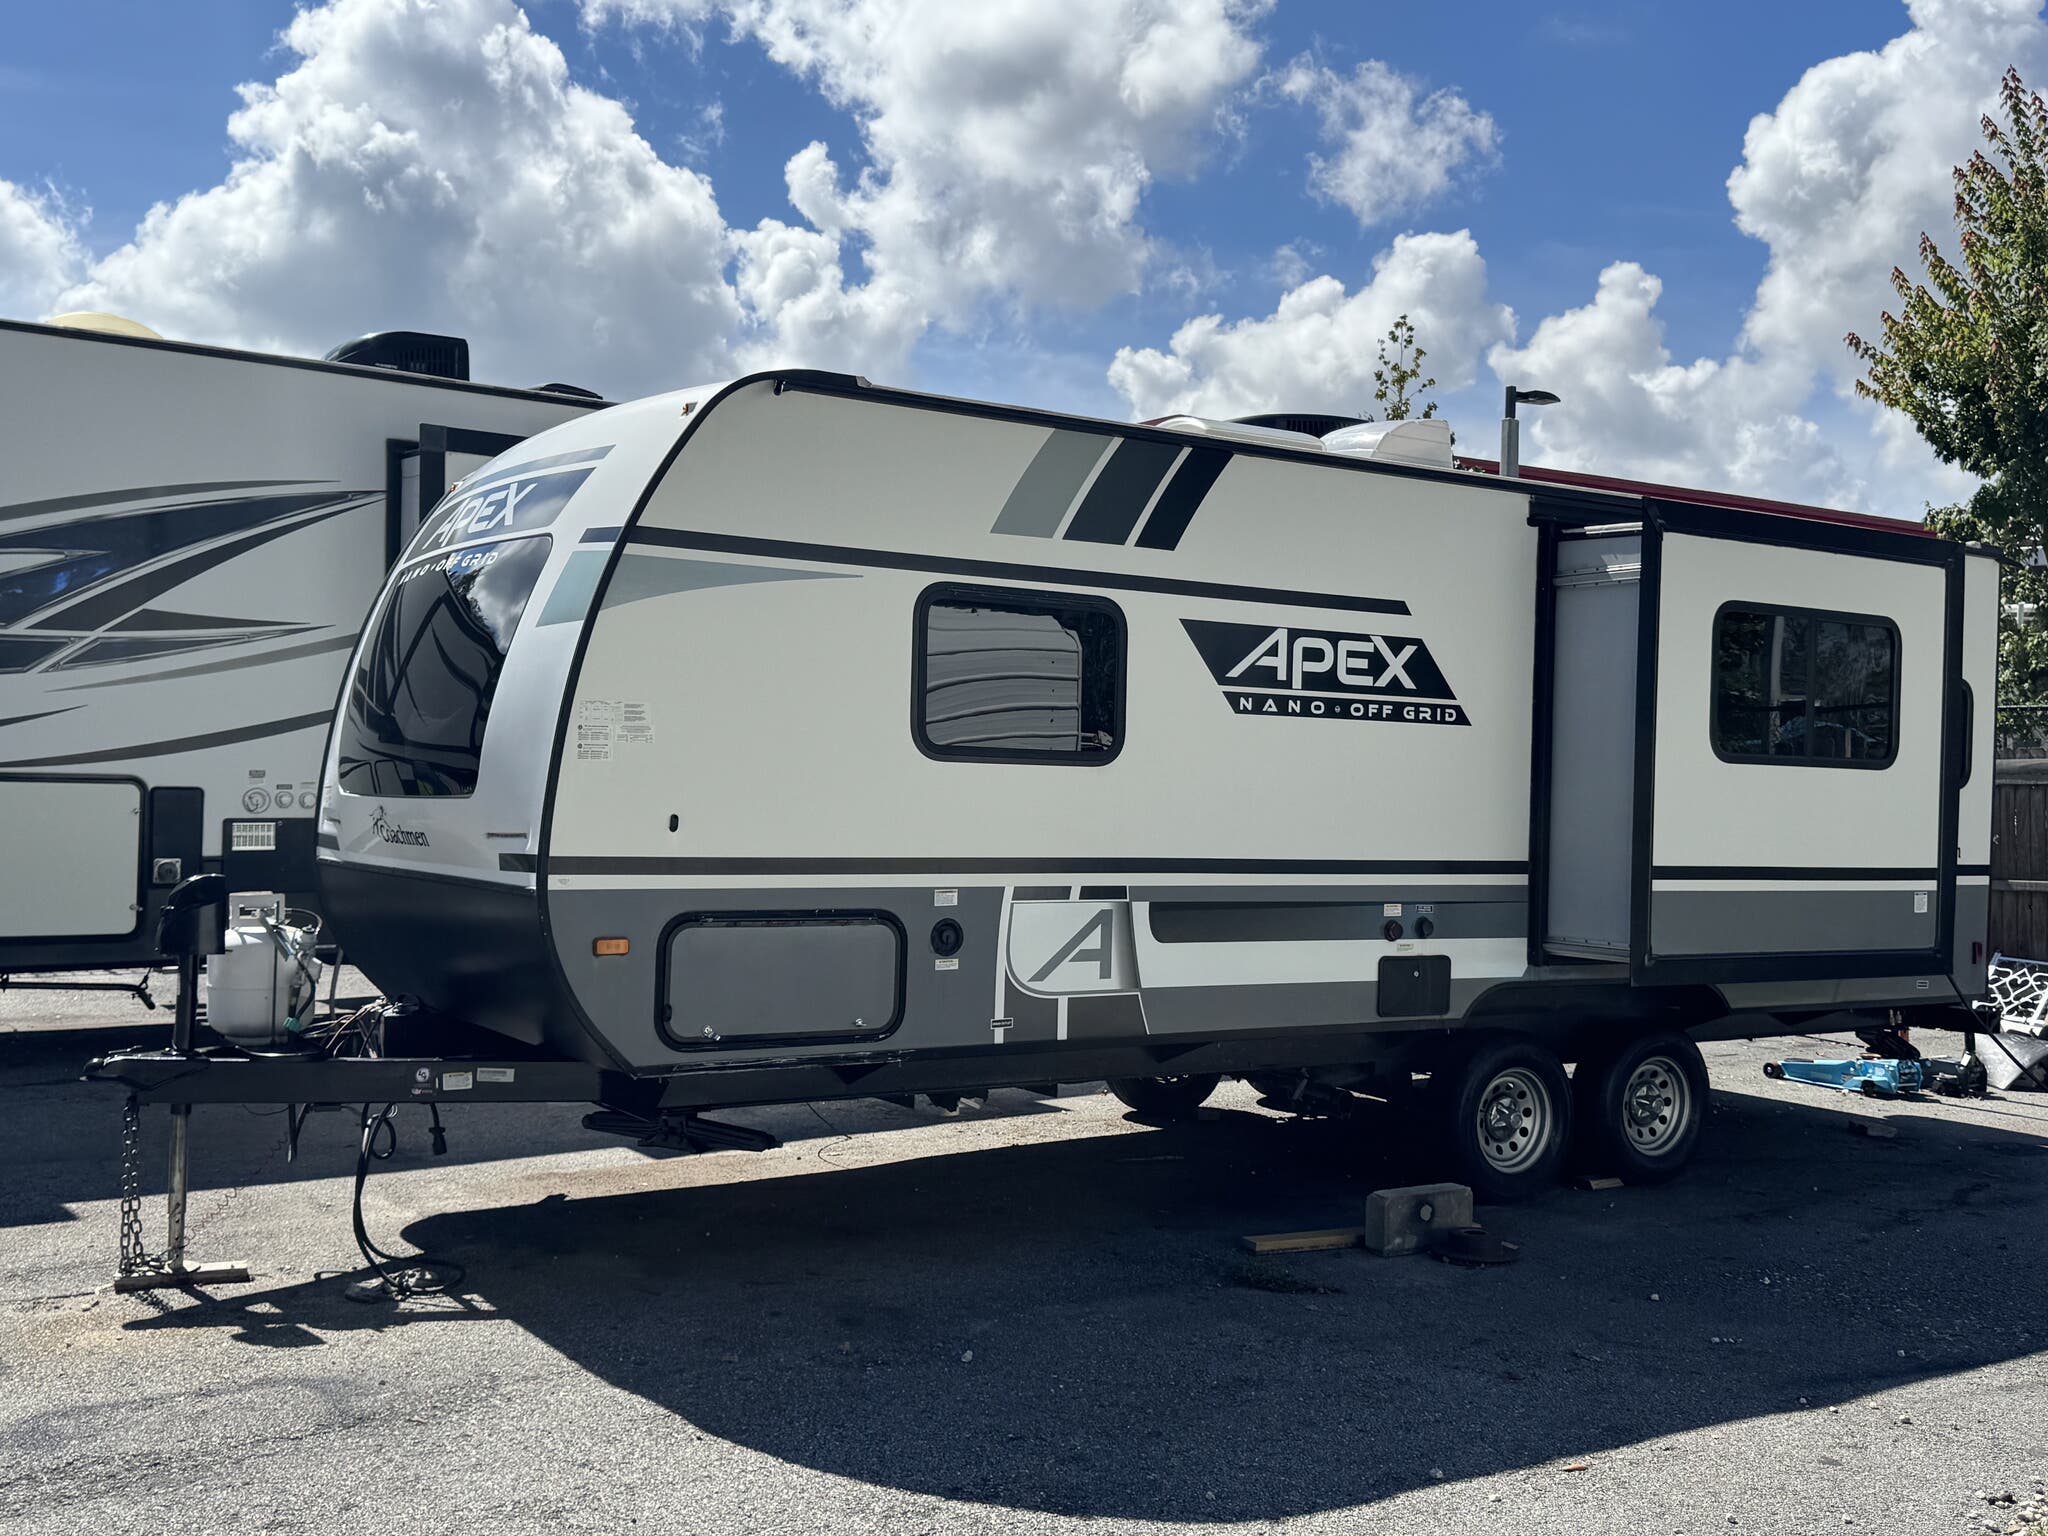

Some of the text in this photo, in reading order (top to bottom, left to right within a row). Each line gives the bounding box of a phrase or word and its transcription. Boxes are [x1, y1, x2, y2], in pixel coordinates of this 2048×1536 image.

[422, 482, 538, 550] APEX
[462, 551, 499, 567] GRID
[1225, 628, 1418, 690] APEX
[1239, 697, 1457, 722] NANO OFF GRID
[380, 824, 430, 847] Coachmen
[1027, 909, 1113, 982] A
